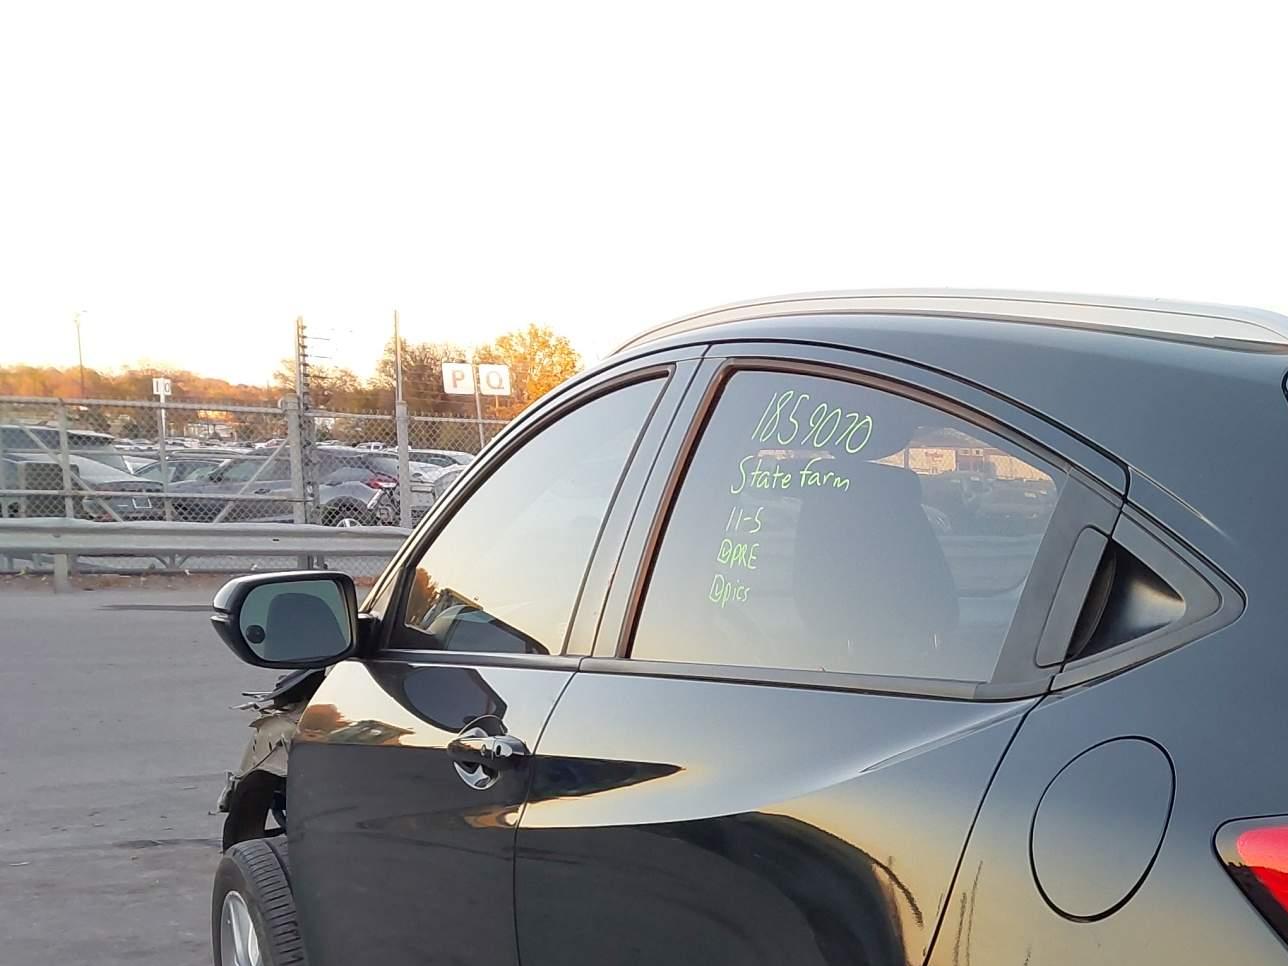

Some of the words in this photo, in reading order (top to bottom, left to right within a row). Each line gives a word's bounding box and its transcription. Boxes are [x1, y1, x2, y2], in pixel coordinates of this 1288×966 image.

[451, 368, 465, 389] P
[485, 370, 505, 390] Q
[730, 455, 792, 494] State
[725, 506, 764, 534] 11-5
